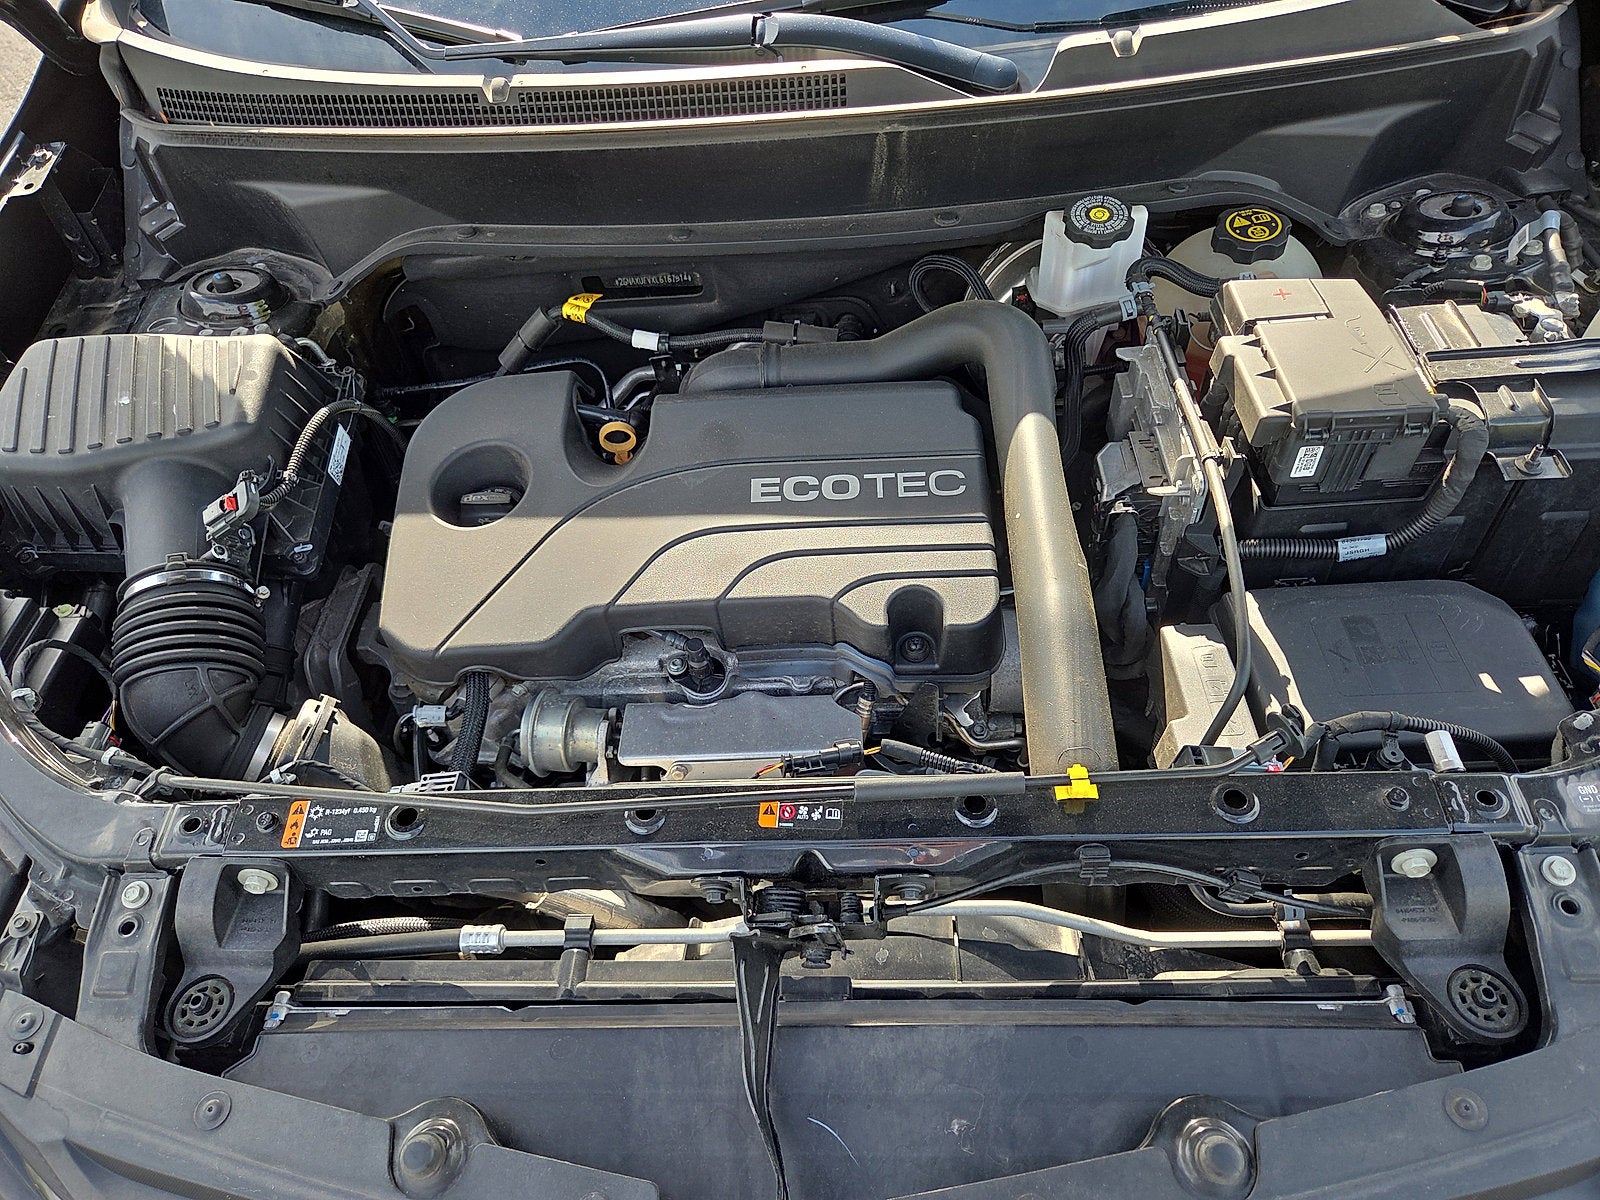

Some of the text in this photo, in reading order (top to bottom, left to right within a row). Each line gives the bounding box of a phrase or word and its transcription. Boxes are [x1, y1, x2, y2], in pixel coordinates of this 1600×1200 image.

[750, 469, 967, 503] ECOTEC
[1577, 784, 1599, 795] GND
[320, 828, 333, 836] PAG
